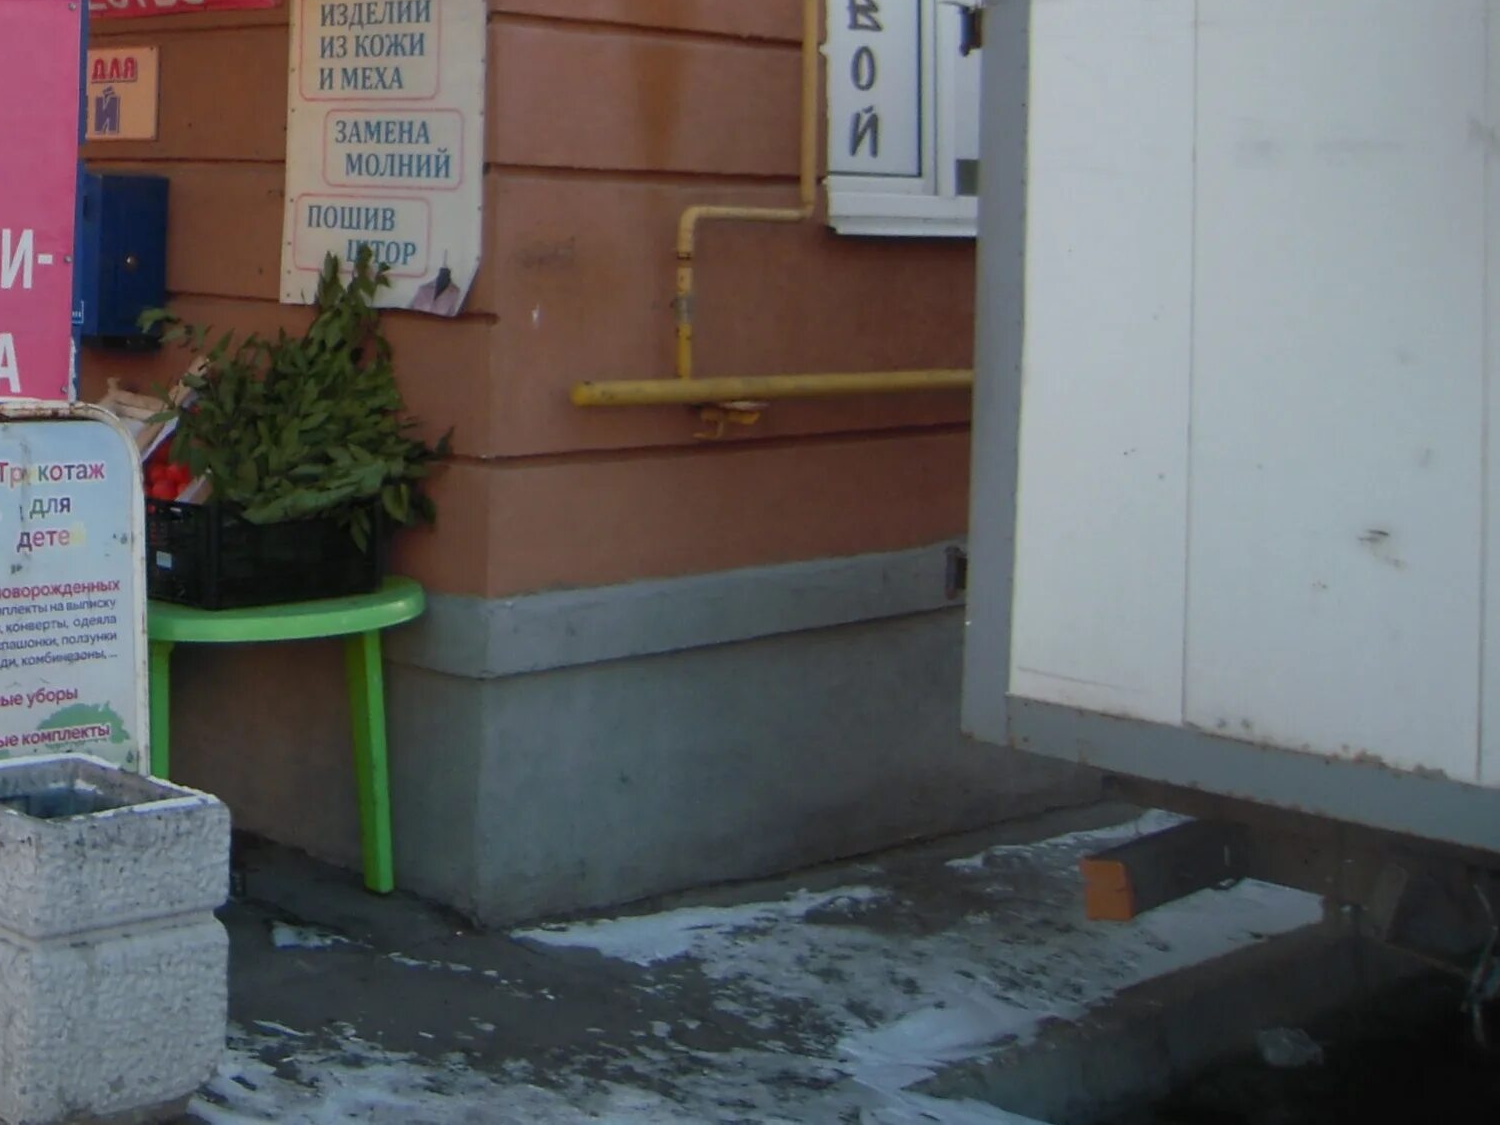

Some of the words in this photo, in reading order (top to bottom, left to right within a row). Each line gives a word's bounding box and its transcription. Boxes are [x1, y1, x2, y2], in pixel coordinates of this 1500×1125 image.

[319, 35, 349, 59] ИЗ
[354, 32, 425, 58] КОЖИ
[318, 69, 336, 92] И
[340, 67, 404, 91] МЕХА
[334, 119, 431, 145] ЗАМЕНА
[345, 147, 451, 179] МОЛНИЙ
[307, 204, 396, 232] ПОШИВ
[29, 496, 71, 519] для
[50, 602, 64, 613] на
[66, 598, 117, 613] выписку
[73, 615, 117, 628] одеяла
[61, 632, 117, 646] ползунки
[26, 687, 79, 709] уборы
[21, 723, 111, 747] комплекты
